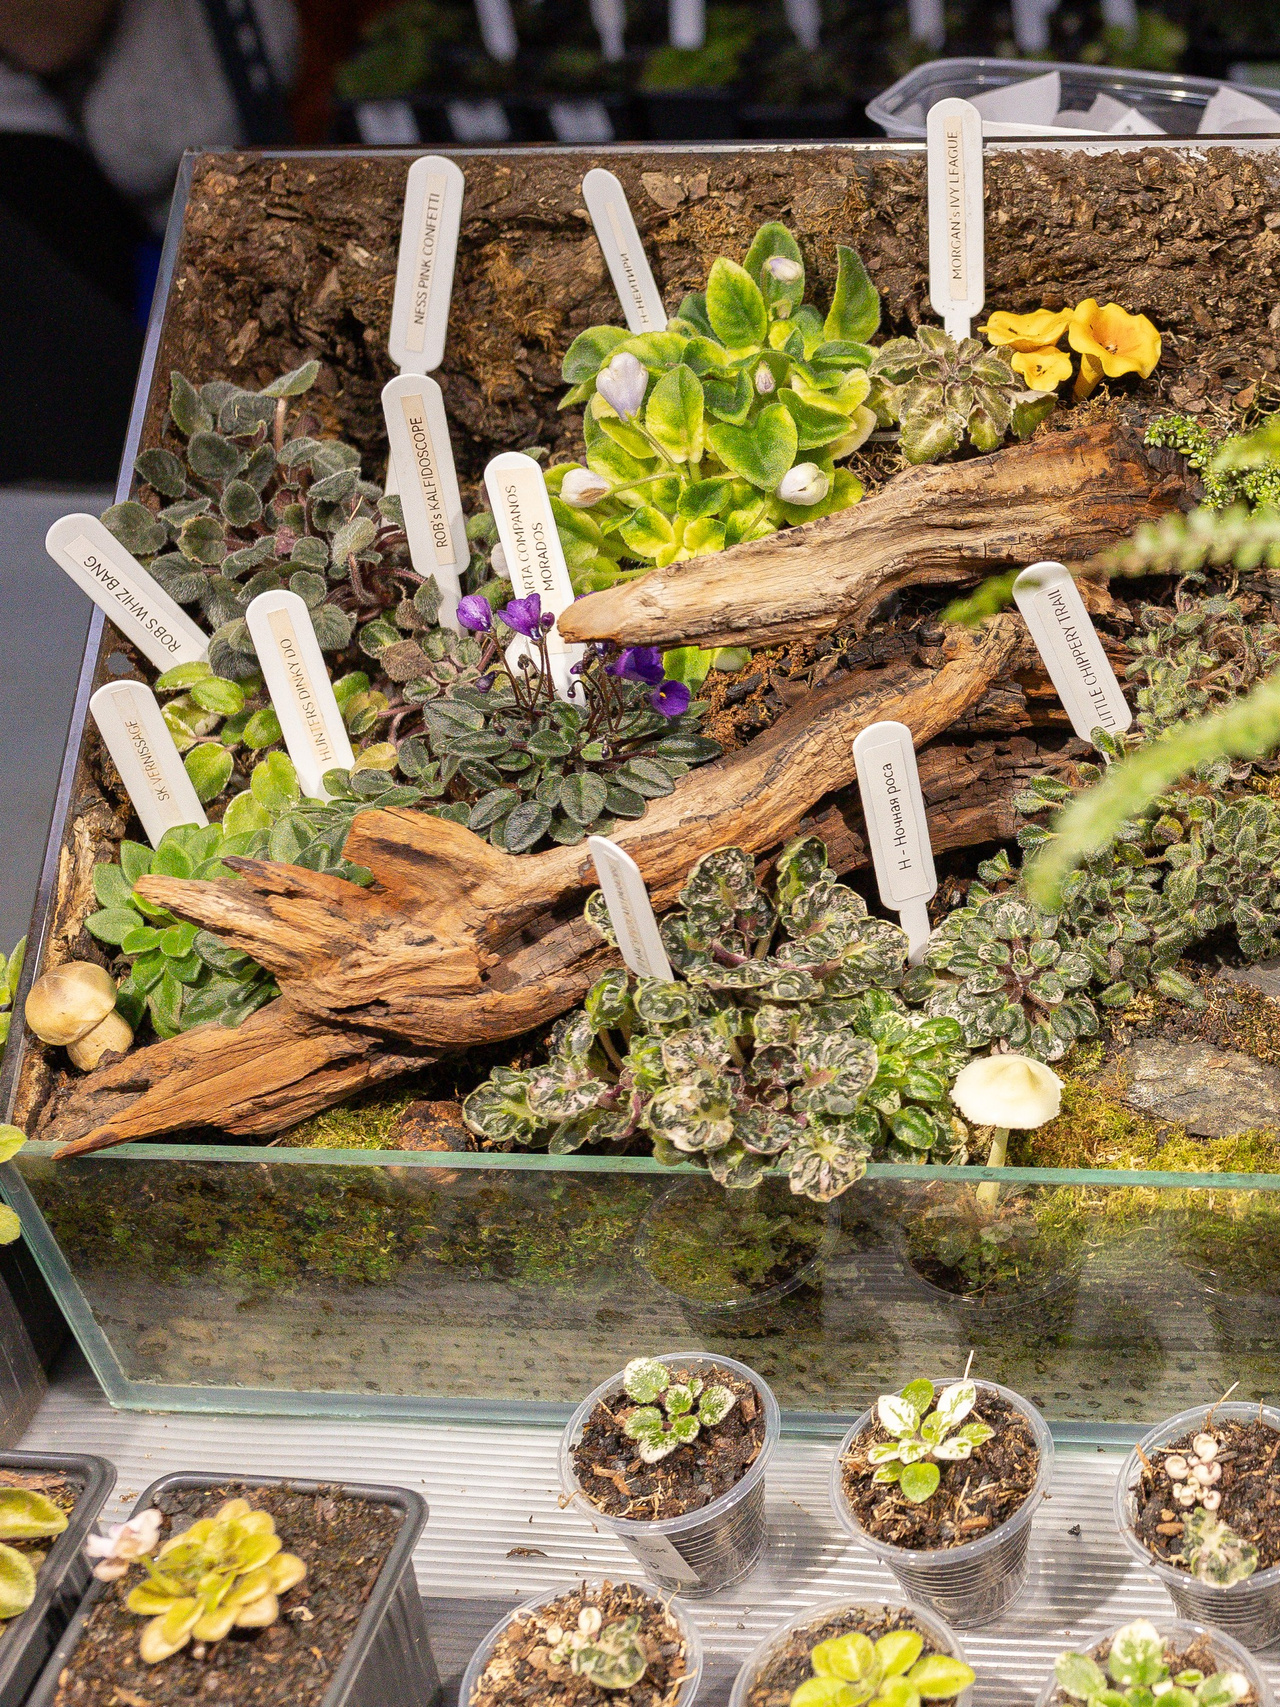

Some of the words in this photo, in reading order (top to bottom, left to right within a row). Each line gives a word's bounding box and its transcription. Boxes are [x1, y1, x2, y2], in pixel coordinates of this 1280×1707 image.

[947, 131, 960, 184] LEAGUE
[949, 185, 960, 209] IVY
[422, 193, 440, 256] CONFETTI
[949, 211, 963, 280] MORGAN's
[417, 259, 432, 289] PINK
[414, 291, 428, 325] NESS
[409, 416, 440, 511] KALEIDOSCOPE
[430, 513, 448, 548] ROB's
[505, 484, 530, 562] COMPANOS
[83, 555, 120, 591] BANG
[532, 522, 555, 591] MORADOS
[115, 587, 149, 622] WHIZ
[145, 618, 182, 653] ROB'S
[279, 638, 298, 658] DO
[1062, 625, 1098, 686] CHIPPERY
[287, 662, 310, 700] DINKY
[1088, 686, 1116, 729] LITTLE
[882, 762, 901, 795] роса
[890, 797, 907, 847] Ночная
